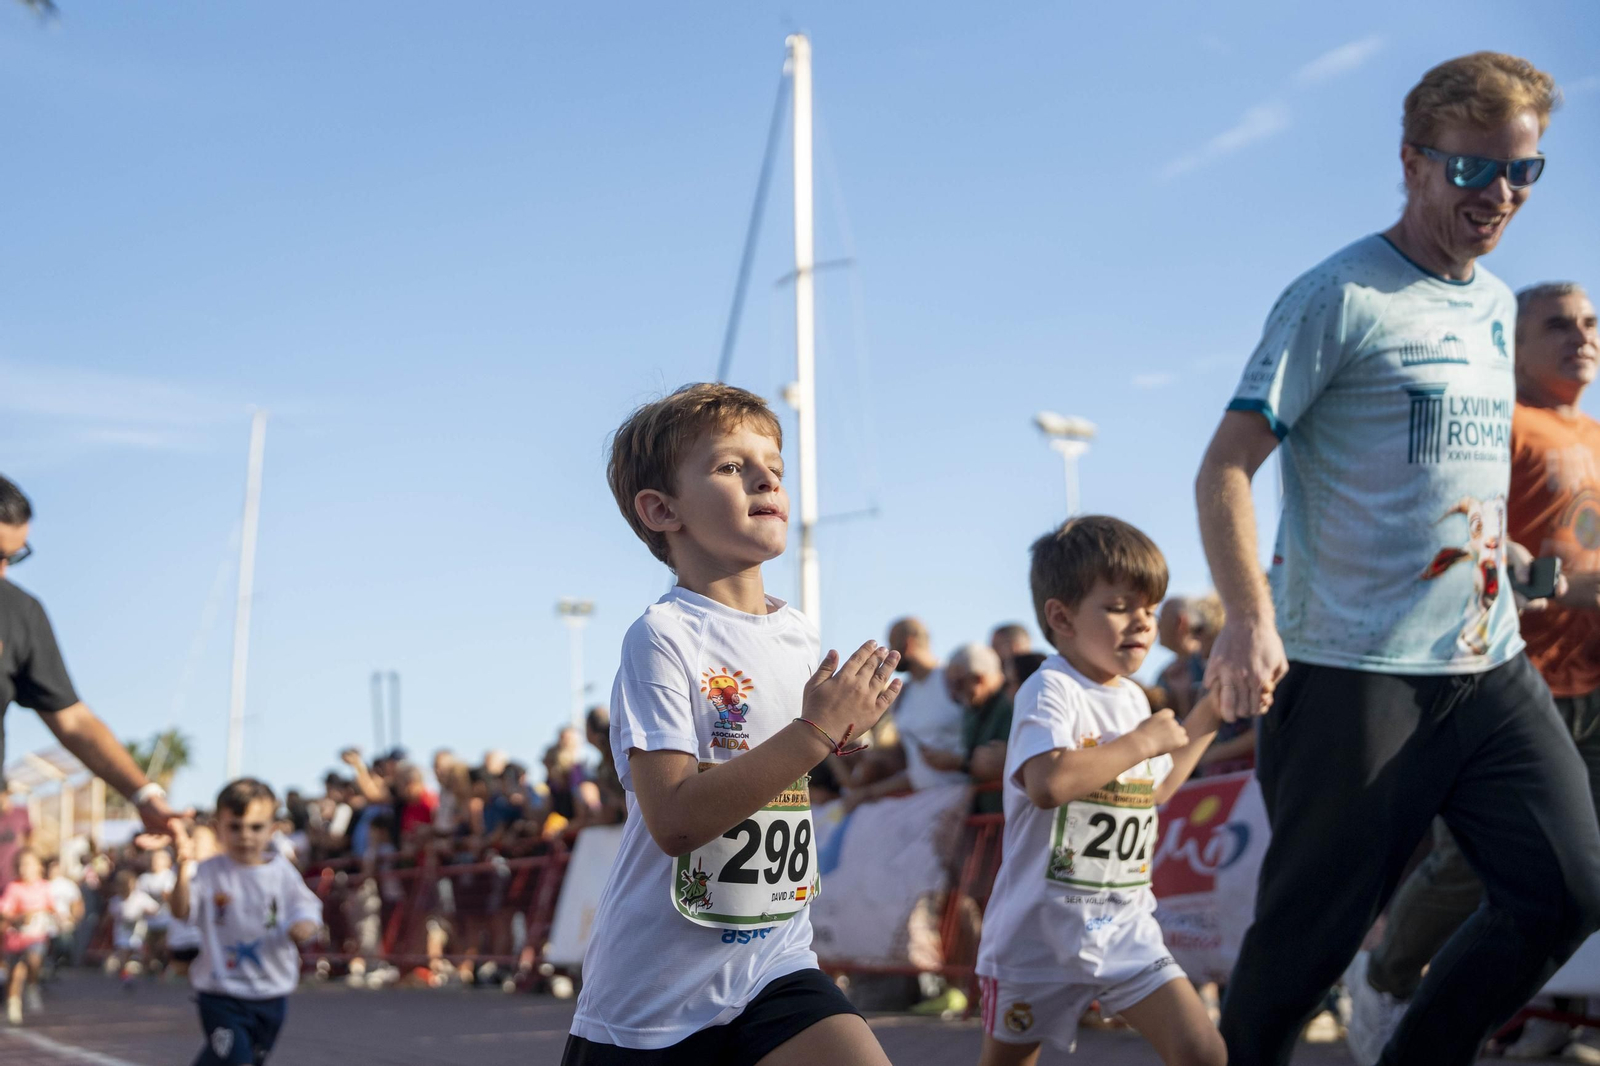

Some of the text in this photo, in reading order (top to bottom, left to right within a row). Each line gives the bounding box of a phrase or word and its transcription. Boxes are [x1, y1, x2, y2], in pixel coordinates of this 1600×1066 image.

[1449, 396, 1489, 417] LXVII
[711, 731, 749, 739] ASOCIACIÓN
[710, 736, 750, 750] AIDA
[717, 818, 811, 885] 298
[771, 891, 787, 902] DAVID
